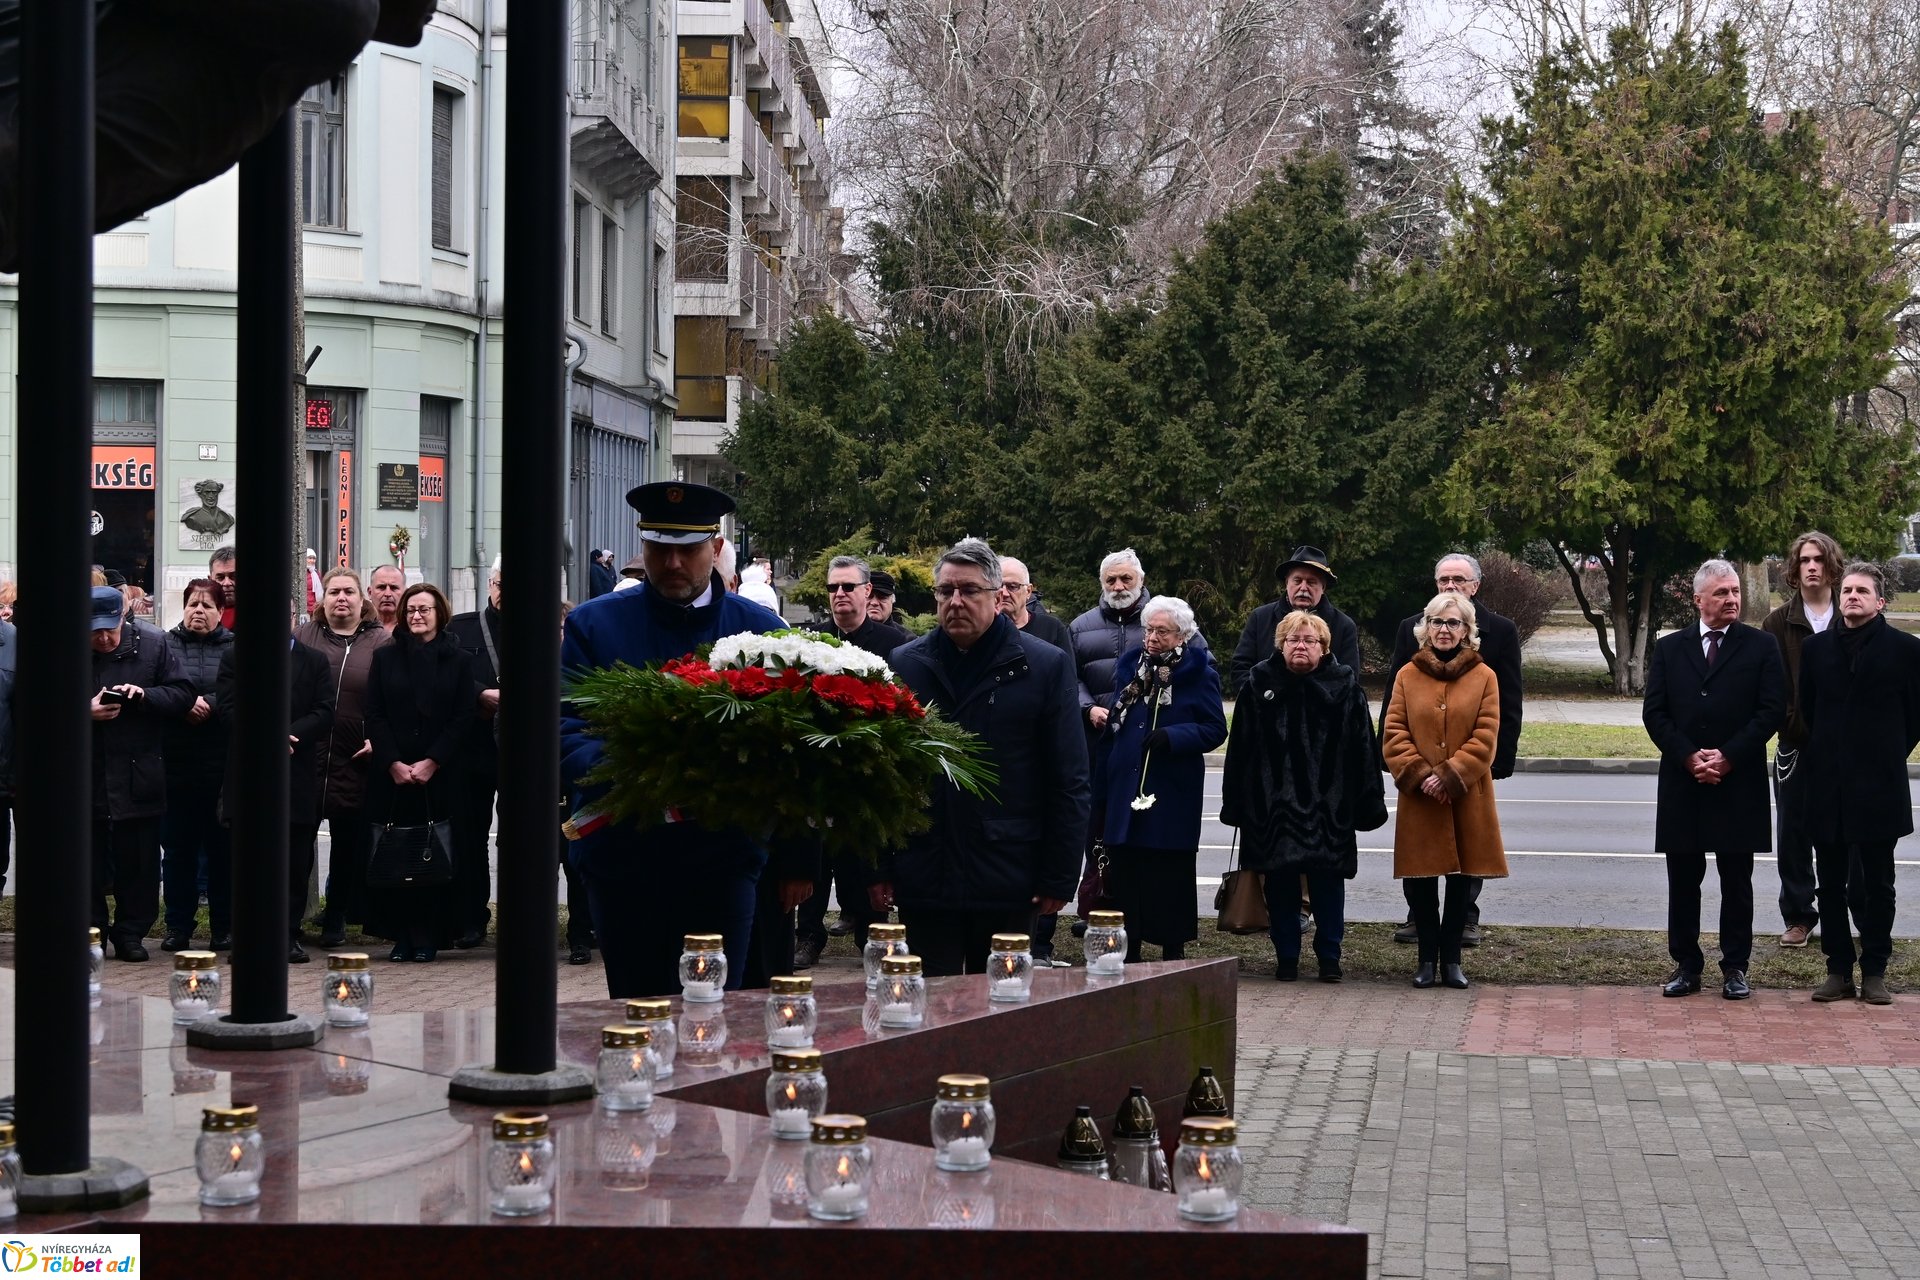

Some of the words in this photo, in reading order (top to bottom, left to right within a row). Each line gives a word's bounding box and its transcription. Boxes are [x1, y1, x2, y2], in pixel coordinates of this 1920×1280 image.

[95, 458, 152, 487] KSÉG
[340, 457, 348, 500] LEONI
[420, 471, 442, 497] ÉKSÉG
